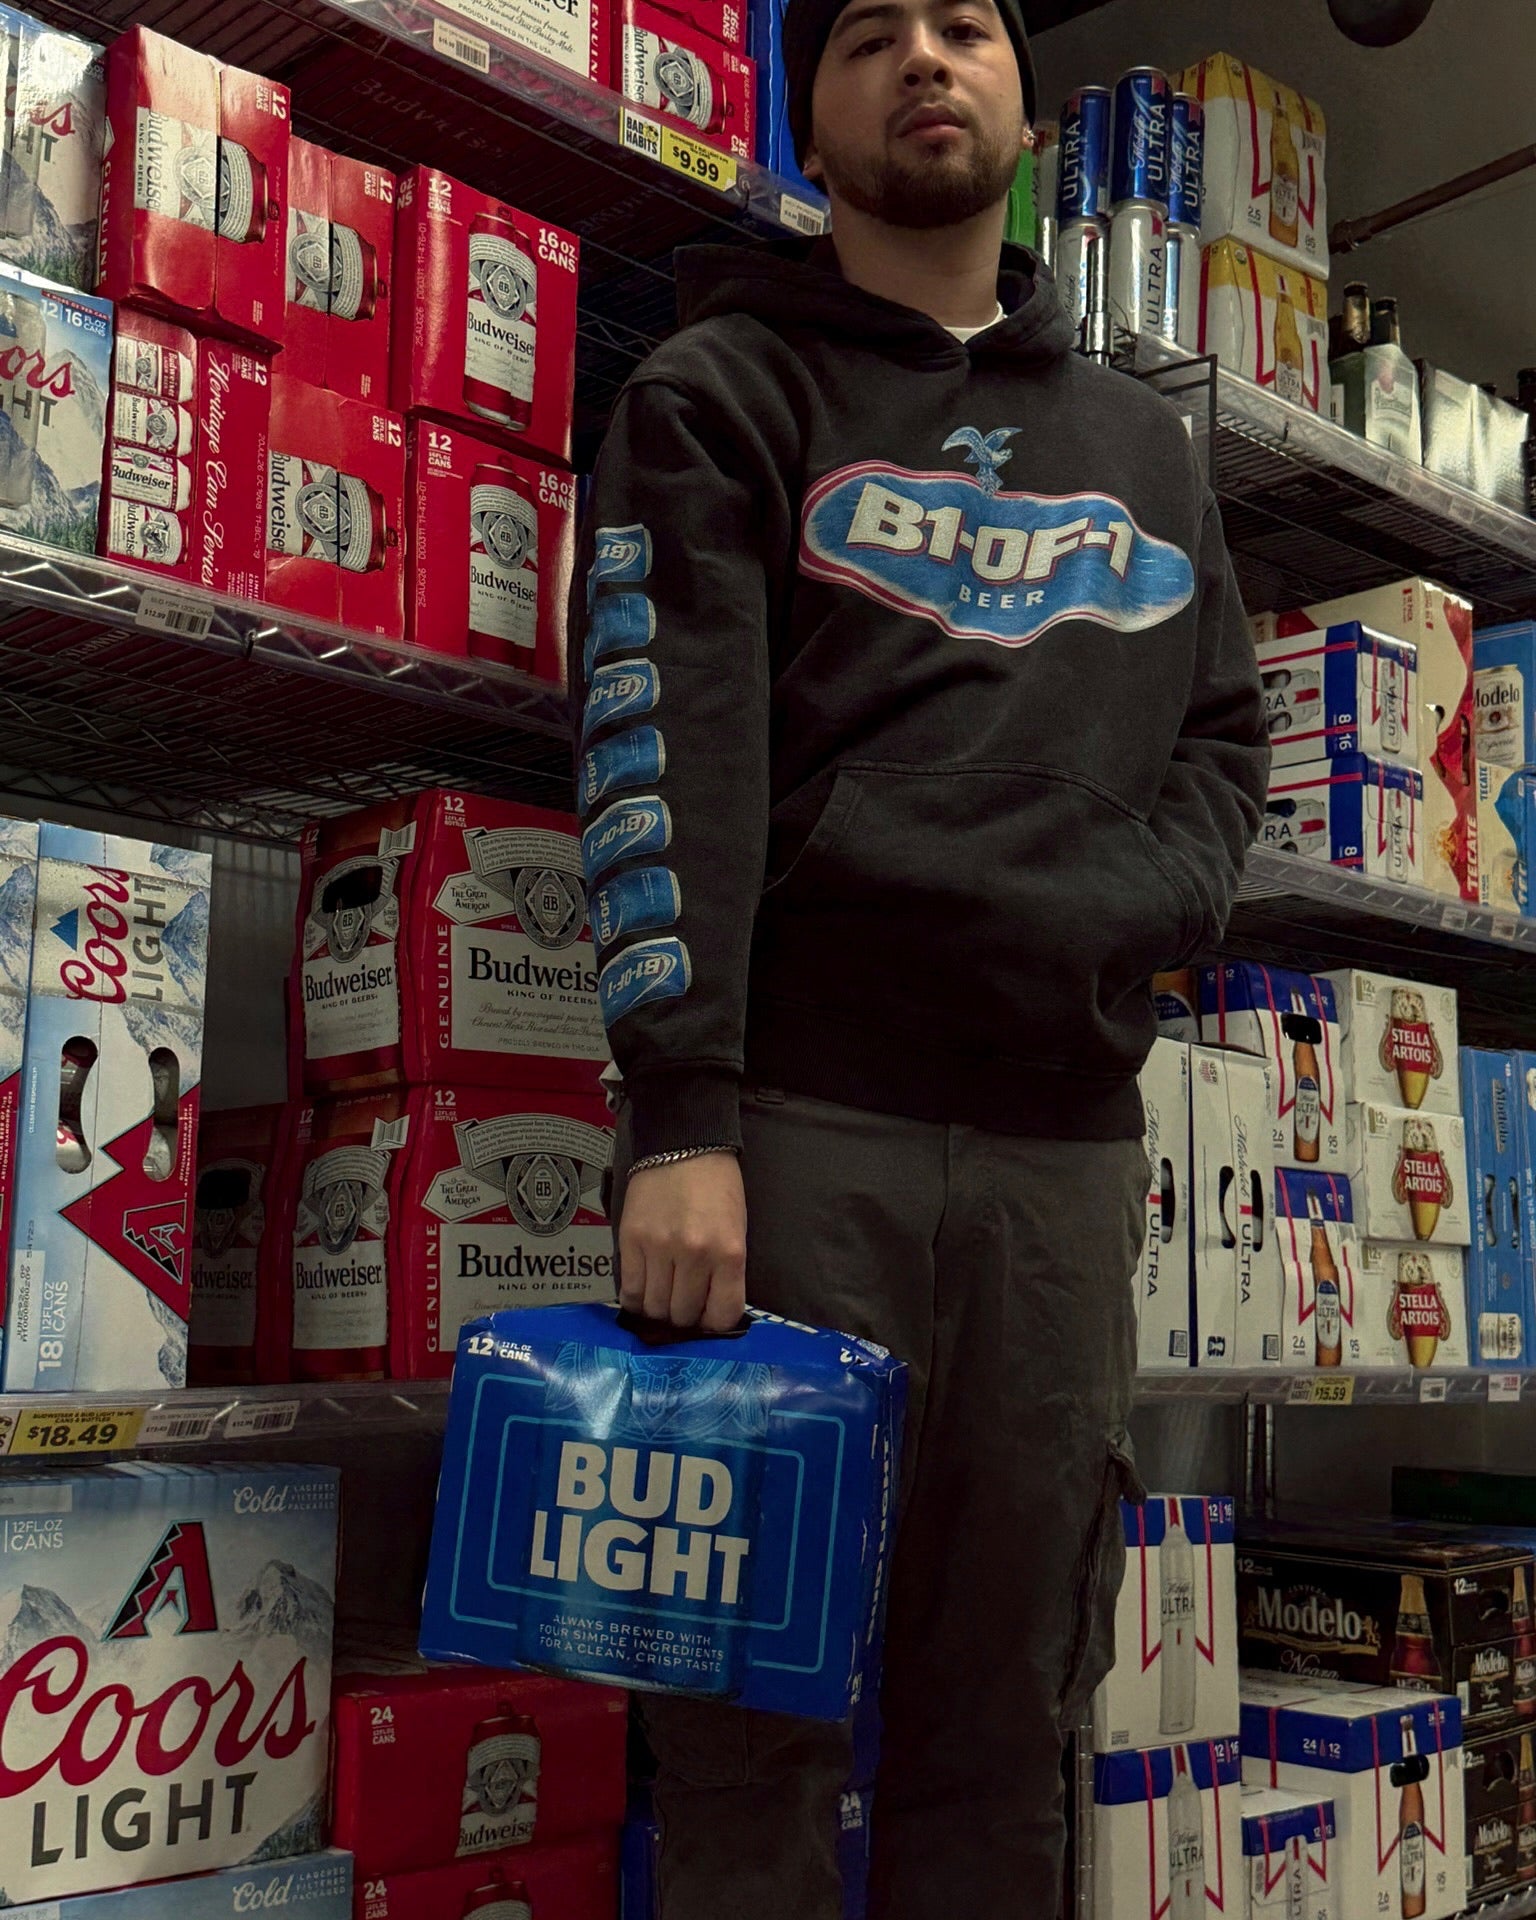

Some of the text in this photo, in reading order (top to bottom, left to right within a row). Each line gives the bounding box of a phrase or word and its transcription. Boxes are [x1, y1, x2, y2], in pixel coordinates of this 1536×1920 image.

[458, 3, 488, 22] PROUDLY
[490, 18, 516, 37] BREWED
[256, 84, 265, 112] CANS
[273, 91, 287, 120] 12
[626, 116, 644, 133] BAD
[626, 130, 658, 155] HABITS
[1147, 104, 1167, 182] ULTRA
[672, 146, 719, 182] $9.99
[1062, 120, 1081, 201] ULTRA
[1184, 131, 1200, 207] ULTRA
[364, 171, 372, 196] CANS
[380, 177, 393, 204] 12
[428, 178, 453, 197] 12
[99, 161, 111, 285] GENUINE
[539, 227, 559, 249] 16
[538, 245, 577, 274] CANS
[1146, 247, 1162, 325] ULTRA
[42, 299, 59, 318] 12
[65, 308, 83, 328] 16
[83, 323, 106, 337] CANS
[0, 346, 76, 397] ors
[240, 356, 249, 380] CANS
[255, 361, 268, 387] 12
[372, 415, 381, 442] CANS
[388, 420, 402, 447] 12
[428, 431, 453, 452] 12
[201, 351, 230, 587] Heritage Can Series
[428, 458, 452, 470] CANS
[112, 465, 171, 490] Budweiser
[538, 471, 559, 491] 16
[538, 489, 575, 513] CANS
[845, 482, 1134, 582] B1-OF-1
[959, 584, 1045, 609] BEER
[1339, 713, 1352, 724] 8
[1387, 685, 1398, 737] ULTRA
[1339, 734, 1352, 751] 16
[1480, 766, 1489, 801] TECATE
[443, 795, 466, 813] 12
[306, 828, 319, 844] 12
[1344, 846, 1358, 856] 8
[1467, 813, 1478, 892] TECATE
[60, 865, 130, 1004] Coors
[131, 877, 167, 1003] LIGHT
[305, 963, 393, 1002] Budweiser
[468, 947, 600, 993] Budweis
[1225, 968, 1235, 979] 12
[437, 923, 450, 1049] GENUINE
[507, 989, 553, 1001] KING OF
[1391, 1027, 1431, 1048] STELLA
[1392, 1047, 1432, 1064] ARTOIS
[434, 1089, 457, 1107] 12
[300, 1108, 315, 1124] 12
[1404, 1159, 1441, 1177] STELLA
[1404, 1176, 1442, 1193] ARTOIS
[1147, 1213, 1160, 1297] ULTRA
[1240, 1224, 1251, 1304] ULTRA
[296, 1259, 382, 1290] Budweiser
[498, 1283, 547, 1291] KING OF
[426, 1223, 438, 1353] GENUINE
[52, 1280, 69, 1332] CANS
[1400, 1294, 1438, 1309] STELLA
[1400, 1310, 1440, 1326] ARTOIS
[39, 1340, 64, 1372] 18
[467, 1336, 495, 1357] 12
[500, 1348, 531, 1362] CANS
[27, 1423, 118, 1446] $18.49
[555, 1441, 733, 1527] BUD
[233, 1485, 290, 1515] Cold
[1208, 1503, 1232, 1517] 12 16
[11, 1532, 63, 1551] CANS
[529, 1510, 750, 1605] LIGHT
[1237, 1557, 1255, 1575] 12
[1454, 1577, 1466, 1595] 12
[1257, 1585, 1363, 1641] Modelo
[539, 1623, 725, 1660] FOUR SIMPLE INGREDIENTS
[553, 1614, 711, 1646] ALWAYS BREWED WITH
[539, 1636, 722, 1673] FOR A CLEAN, CRISP TASTE
[0, 1635, 316, 1799] Coors
[369, 1705, 395, 1725] 24
[372, 1733, 396, 1745] CANS
[1215, 1741, 1240, 1757] 12 16
[1302, 1737, 1341, 1755] 24 12
[840, 1793, 861, 1810] 24
[31, 1772, 257, 1868] LIGHT
[296, 1877, 346, 1891] FILTERED
[300, 1867, 346, 1881] LAGERED
[233, 1874, 295, 1913] Cold
[292, 1887, 346, 1902] PACKAGED
[363, 1879, 388, 1900] 24
[365, 1908, 389, 1920] CANS
